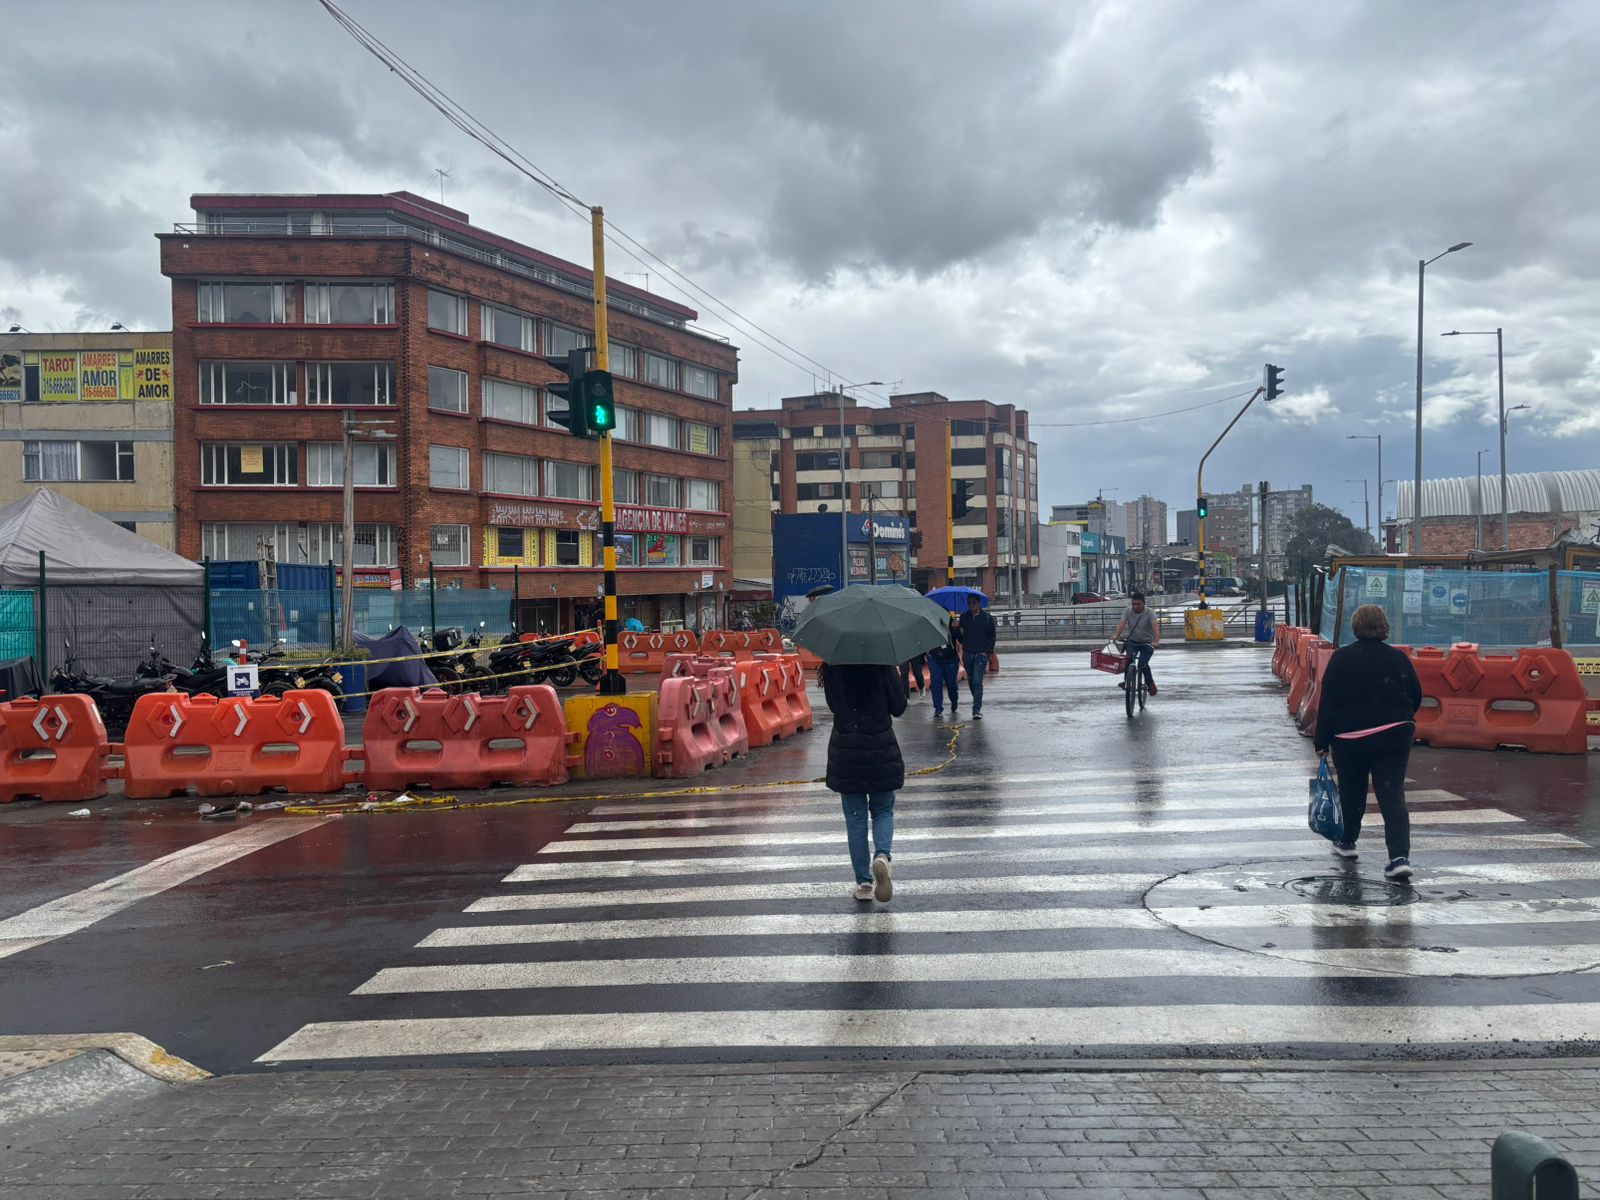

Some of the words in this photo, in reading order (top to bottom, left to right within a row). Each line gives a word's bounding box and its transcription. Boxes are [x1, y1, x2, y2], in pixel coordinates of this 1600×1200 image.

[42, 358, 76, 372] TAROT
[82, 353, 117, 367] AMARRES
[135, 351, 170, 365] AMARRES
[82, 370, 117, 387] AMOR
[145, 368, 161, 381] DE
[138, 384, 170, 398] AMOR
[616, 508, 650, 531] AGENCIA
[651, 511, 662, 532] DE
[663, 511, 687, 533] VIAJES
[872, 522, 905, 539] Domino's
